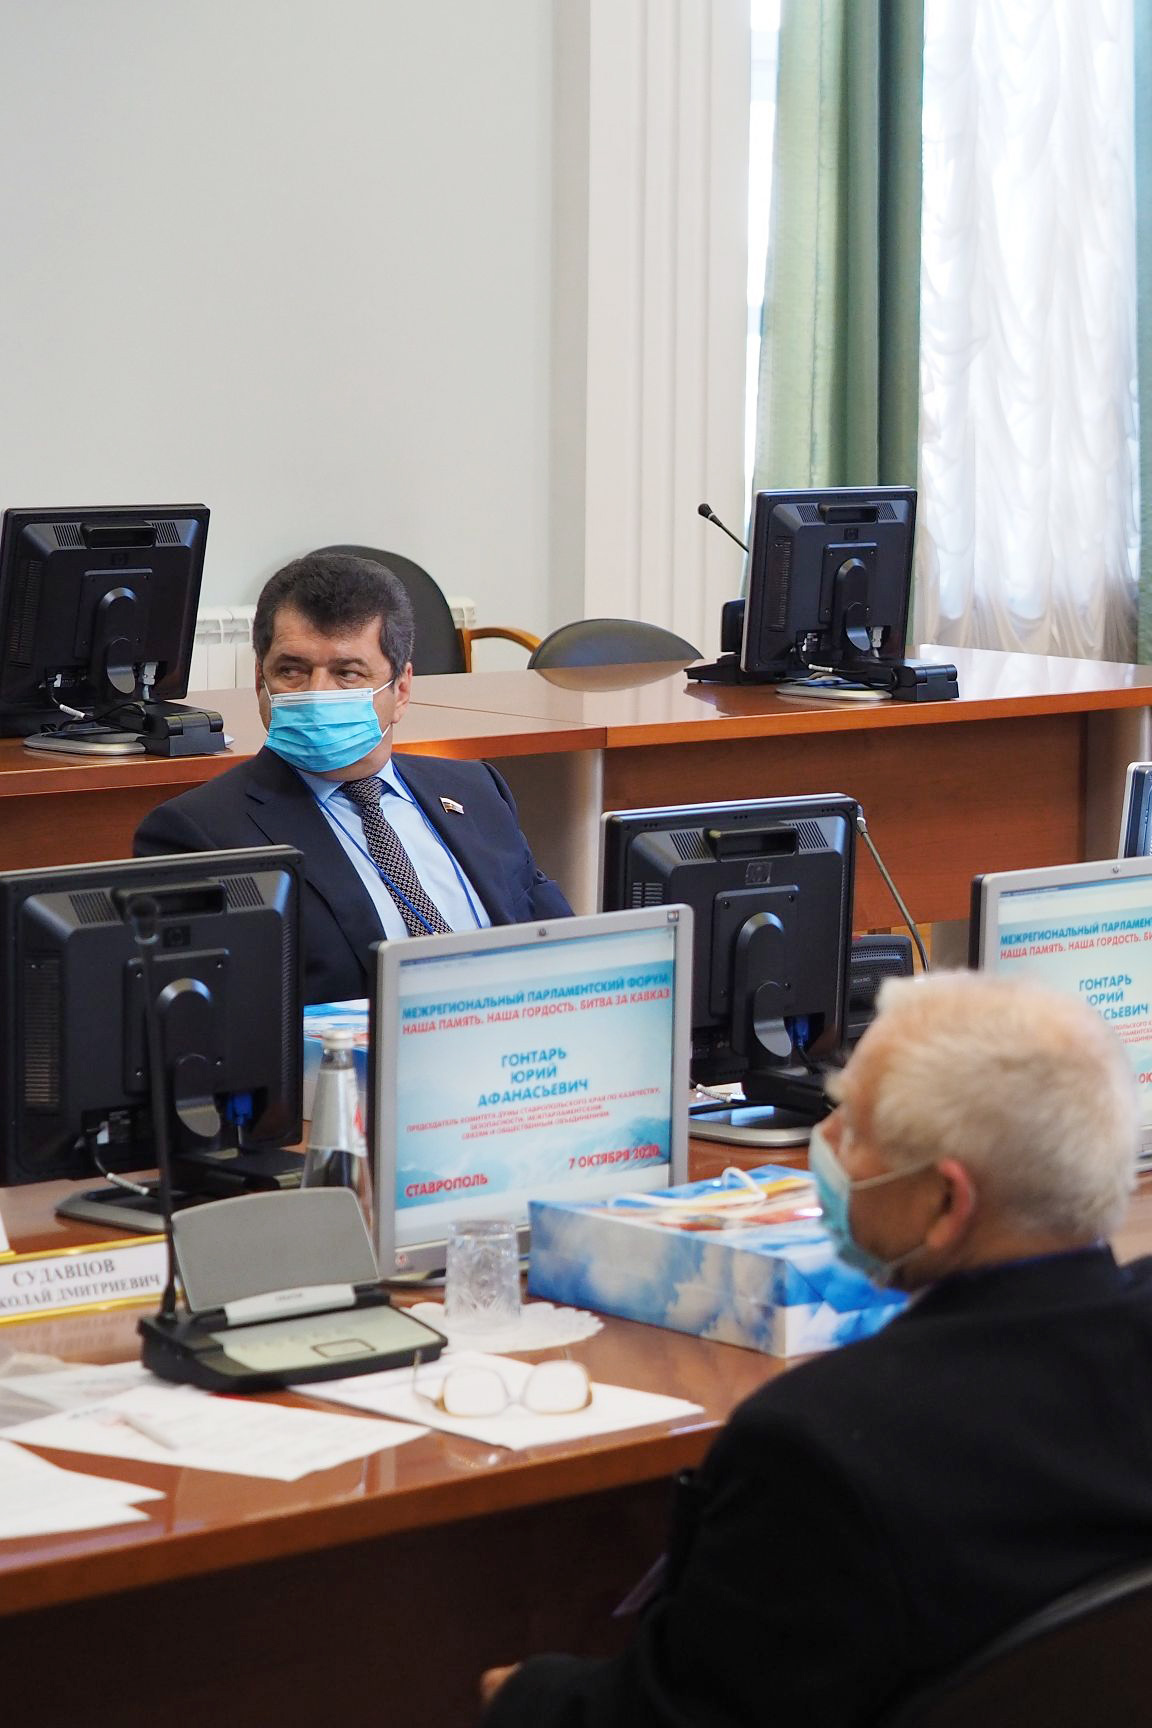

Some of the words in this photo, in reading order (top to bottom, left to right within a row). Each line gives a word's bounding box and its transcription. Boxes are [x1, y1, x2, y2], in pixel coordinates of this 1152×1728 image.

[1000, 923, 1099, 945] МЕЖРЕГИОНАЛЬНЫЙ
[1000, 946, 1027, 960] НАША
[1029, 941, 1066, 956] ПАМЯТЬ.
[1068, 938, 1094, 951] НАША
[1096, 932, 1141, 948] ГОРДОСТЬ.
[1080, 974, 1132, 991] ГОНТАРЬ
[402, 991, 524, 1020] МЕЖРЕГИОНАЛЬНЫЙ
[527, 978, 624, 1003] ПАРЛАМЕНТСКИЙ
[626, 973, 668, 989] ФОРУМ
[402, 1020, 436, 1035] НАША
[438, 1013, 484, 1030] ПАМЯТЬ.
[486, 1008, 519, 1023] НАША
[522, 1000, 576, 1018] ГОРДОСТЬ.
[580, 995, 612, 1010] БИТВА
[615, 993, 627, 1006] ЗА
[630, 987, 670, 1004] КАВКАЗ
[1103, 1004, 1148, 1020] СЬЕВИЧ
[502, 1047, 567, 1068] ГОНТАРЬ
[510, 1063, 557, 1084] ЮРИЙ
[478, 1078, 588, 1107] АФАНАСЬЕВИЧ
[569, 1159, 575, 1170] 7
[579, 1148, 630, 1168] ОКТЯБРЯ
[406, 1173, 488, 1198] СТАВРОПОЛЬ
[13, 1259, 114, 1286] СУДАВЦОВ
[0, 1289, 52, 1308] КОЛАЙ
[58, 1274, 161, 1300] ДМИТРИЕВИЧ
